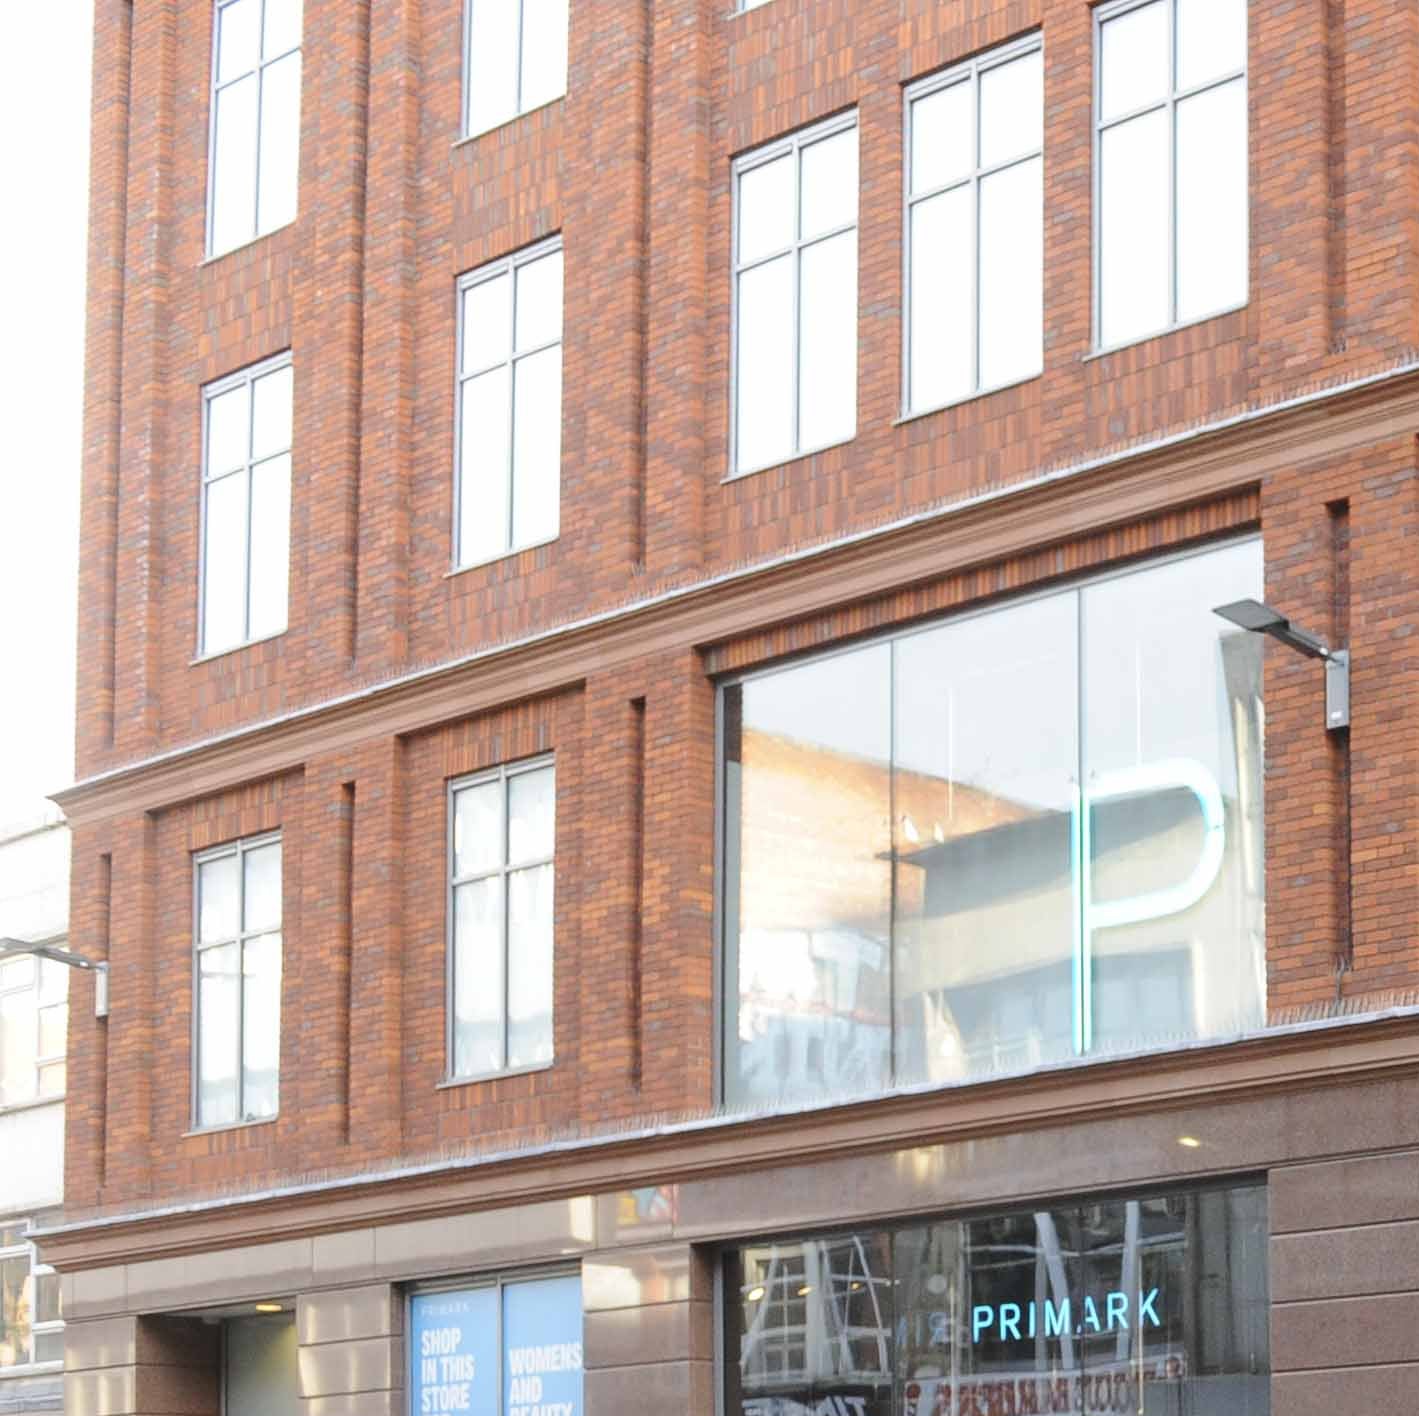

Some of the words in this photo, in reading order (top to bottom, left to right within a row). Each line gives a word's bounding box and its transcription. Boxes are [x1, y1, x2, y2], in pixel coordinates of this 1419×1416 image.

[971, 1287, 1162, 1345] PRIMARK
[421, 1328, 462, 1356] SHOP
[421, 1358, 437, 1384] IN
[440, 1354, 475, 1382] THIS
[508, 1342, 583, 1375] WOMENS
[421, 1384, 470, 1412] STORE
[509, 1376, 544, 1404] AND
